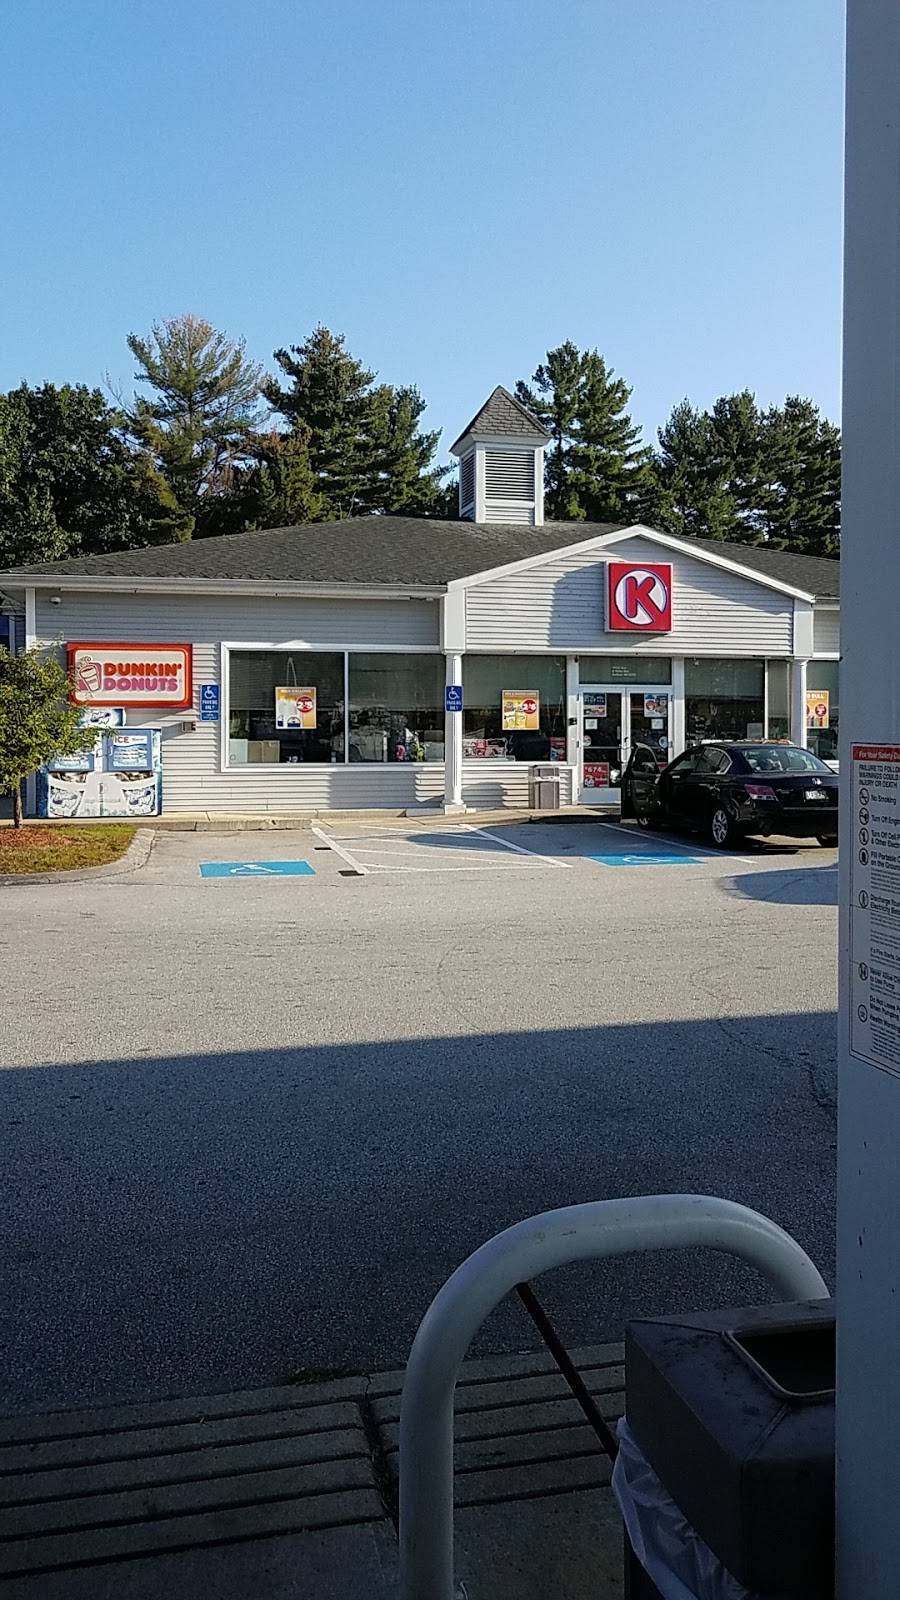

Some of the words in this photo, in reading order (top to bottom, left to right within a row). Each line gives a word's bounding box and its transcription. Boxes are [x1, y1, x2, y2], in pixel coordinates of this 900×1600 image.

[103, 662, 182, 677] DUNKIN'
[103, 677, 178, 692] DONUTS
[114, 736, 130, 744] ICE
[859, 750, 867, 758] For
[871, 794, 877, 802] No
[878, 795, 897, 805] Smoking
[871, 814, 880, 822] Turn
[871, 829, 880, 837] Turn
